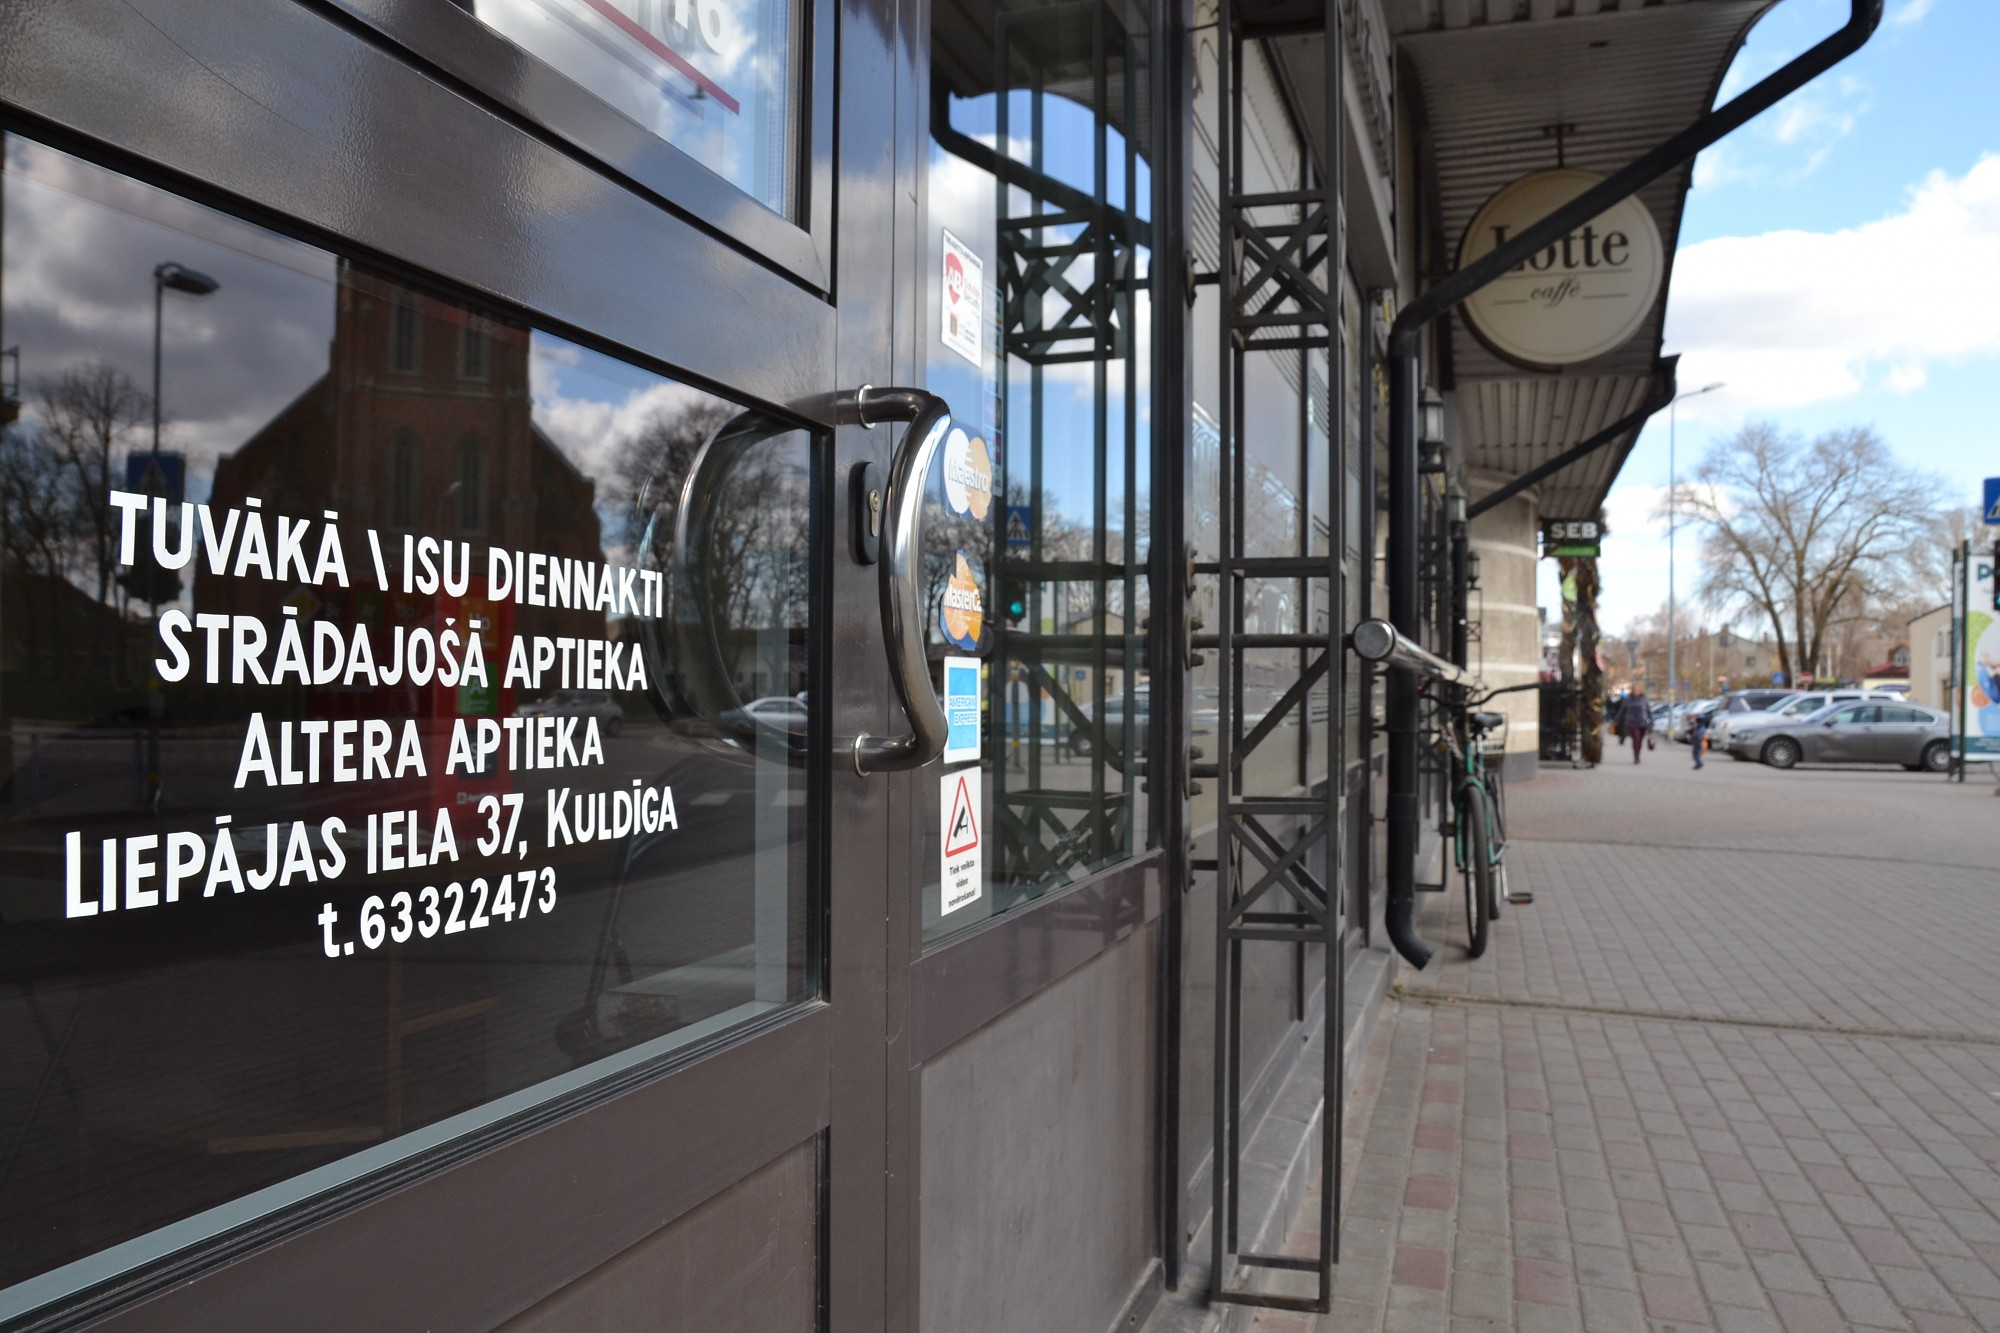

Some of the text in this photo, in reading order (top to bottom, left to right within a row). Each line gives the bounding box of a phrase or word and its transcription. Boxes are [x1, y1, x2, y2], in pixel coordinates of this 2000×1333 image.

[948, 457, 988, 493] Maestro
[109, 490, 349, 588] TUVĀKĀ
[488, 546, 663, 618] DIENNAKTI
[1550, 521, 1598, 539] SEB
[155, 606, 648, 691] STRĀDAJOŠĀ APTIEKA
[233, 713, 427, 789] ALTERA
[445, 716, 605, 775] APTIEKA
[66, 779, 679, 919] LIEPĀJAS IELA 37, KULDĪGA
[956, 878, 968, 888] video
[318, 867, 557, 958] t.63322473
